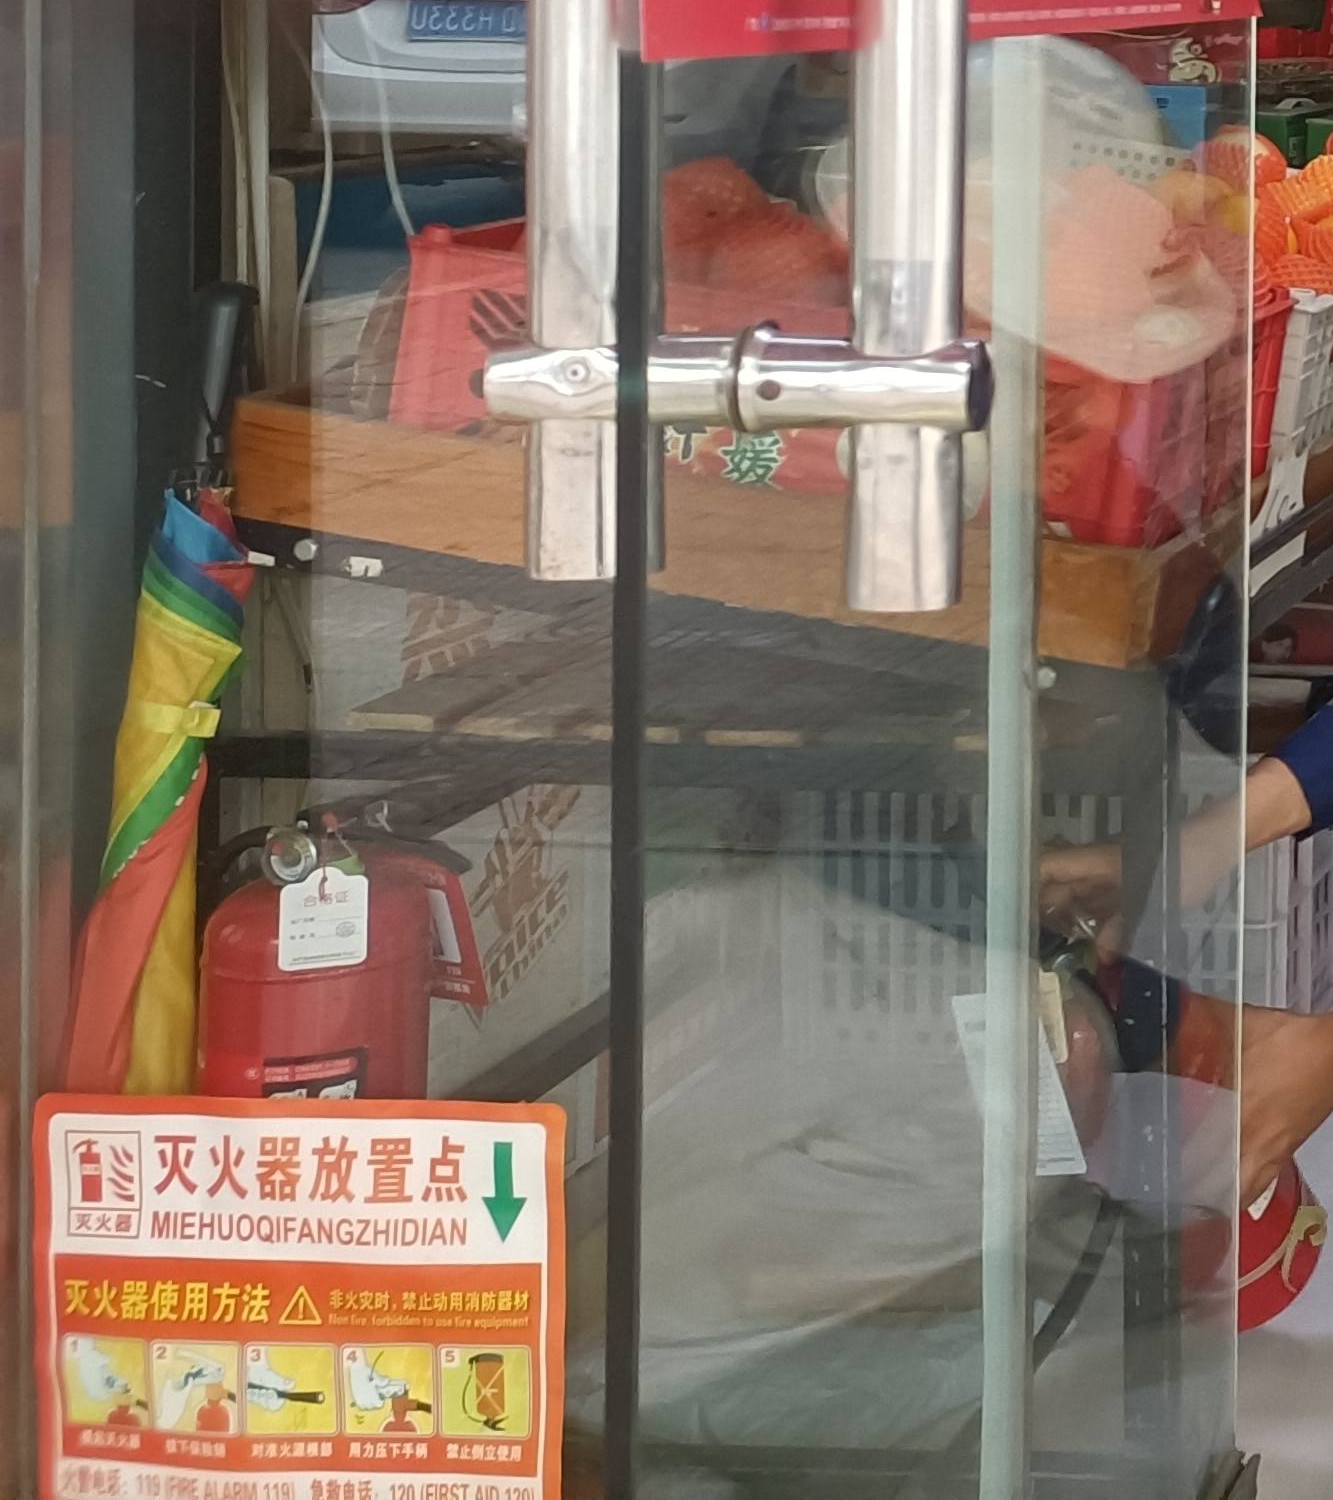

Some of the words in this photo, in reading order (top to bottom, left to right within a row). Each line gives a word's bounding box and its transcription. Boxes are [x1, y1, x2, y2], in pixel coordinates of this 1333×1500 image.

[153, 1133, 468, 1203] 灭火器放置点
[75, 1214, 132, 1234] 灭火器
[150, 1210, 467, 1247] MIEHUOQIFANGZHIDIAN
[64, 1279, 271, 1323] 灭火器使用方法
[156, 1346, 167, 1359] 2
[250, 1348, 262, 1362] 3
[346, 1350, 358, 1364] 4
[444, 1350, 456, 1364] 5
[349, 1441, 428, 1460] 用力压下手柄
[446, 1442, 523, 1463] 禁止倒立使用
